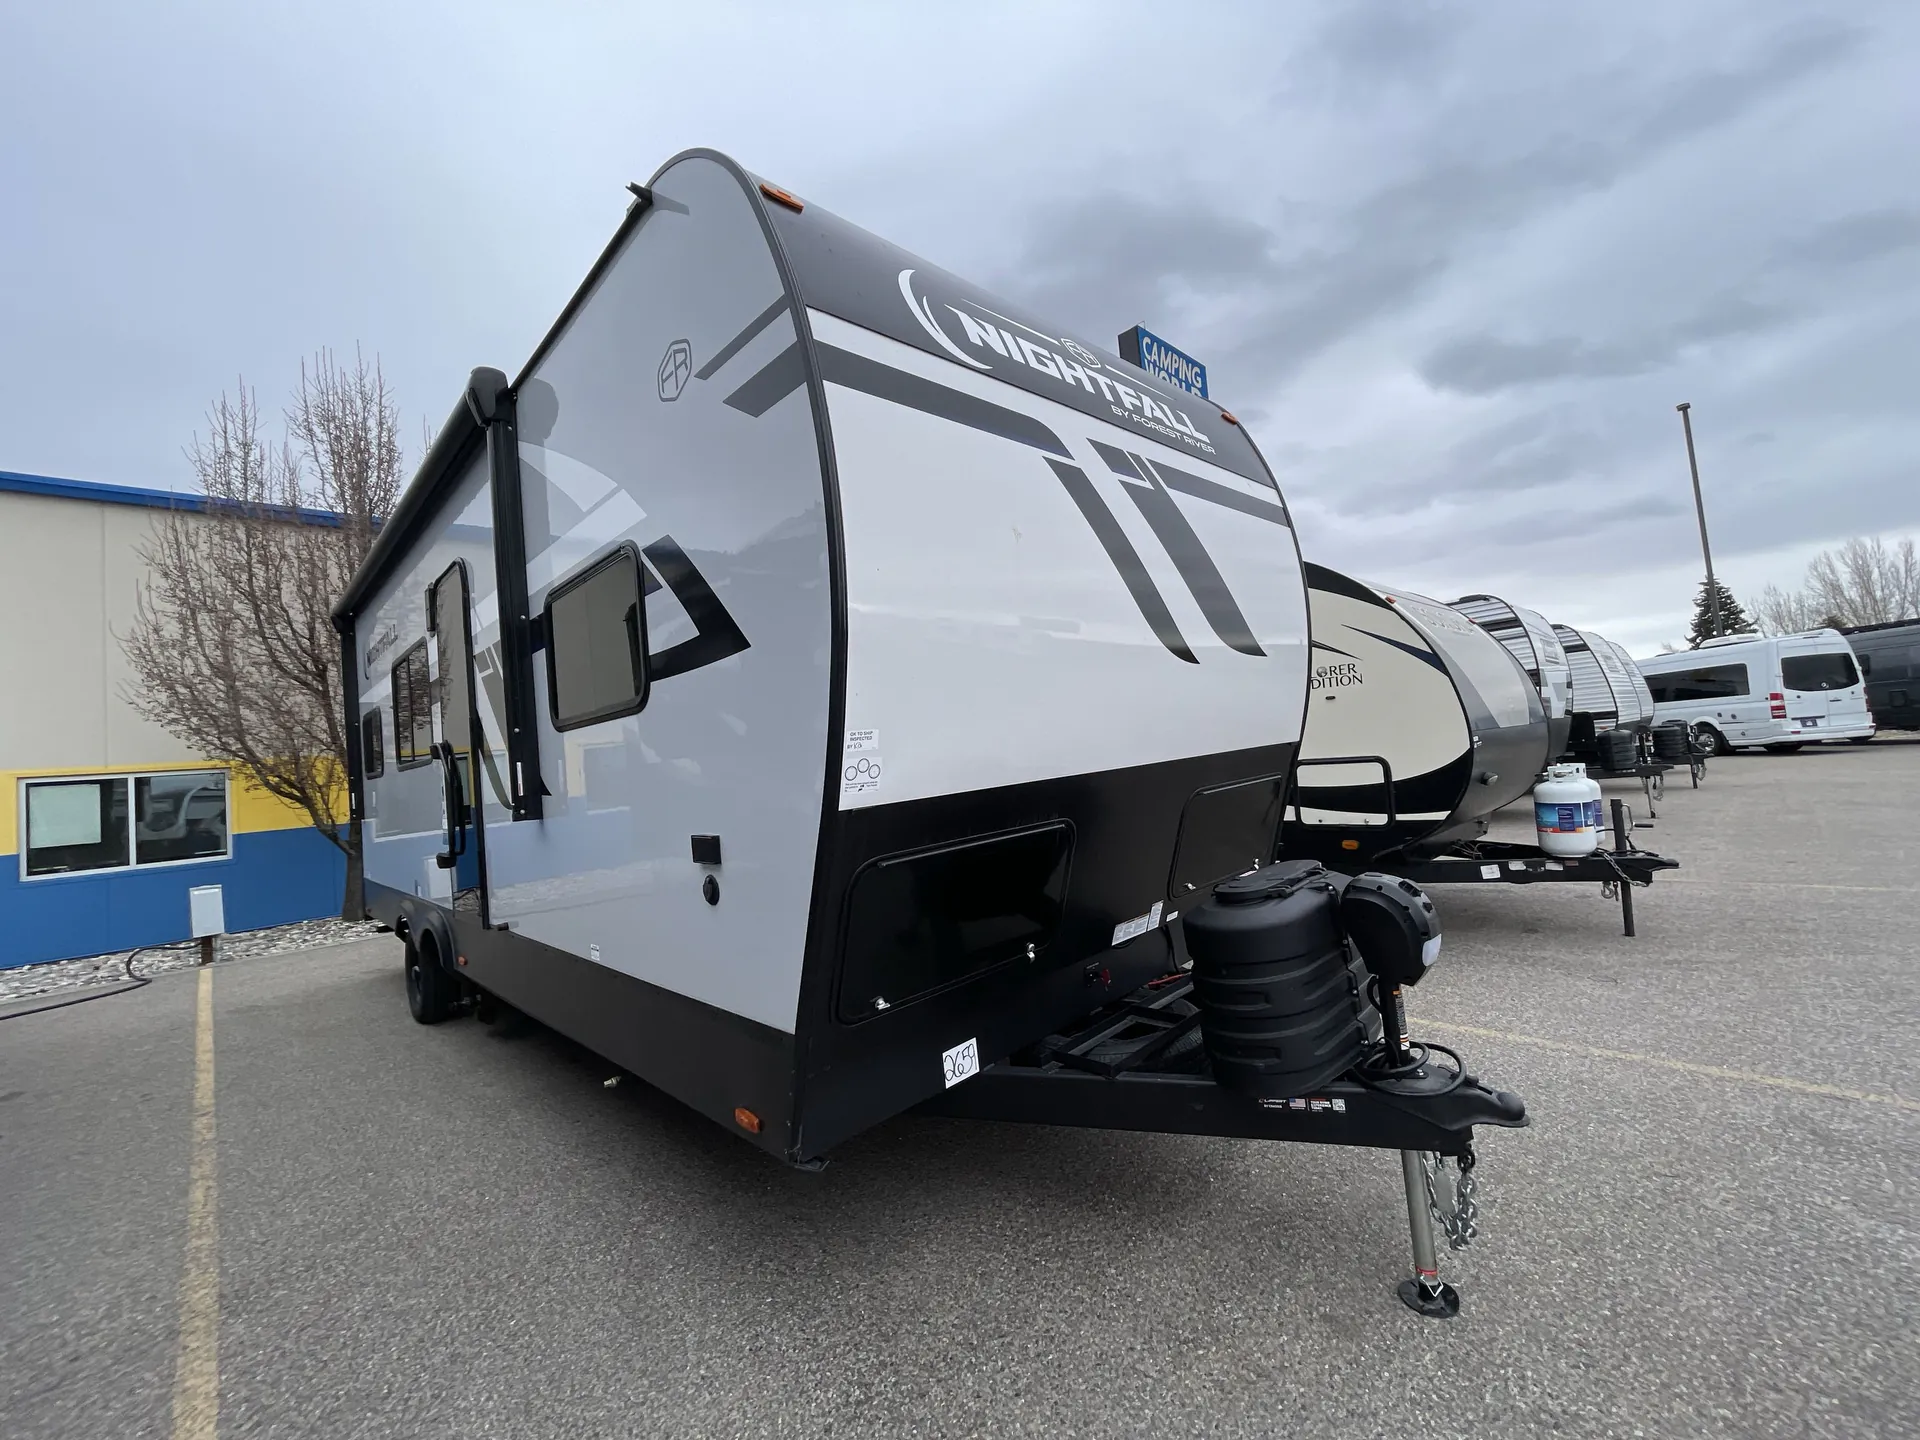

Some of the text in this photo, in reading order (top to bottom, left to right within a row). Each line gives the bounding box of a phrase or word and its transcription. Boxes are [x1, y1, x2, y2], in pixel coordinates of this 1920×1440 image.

[944, 304, 1210, 443] NIGHTFALL
[1143, 336, 1202, 389] CAMPING
[1111, 405, 1216, 455] BY FOREST RIVER
[1311, 673, 1363, 690] DITION
